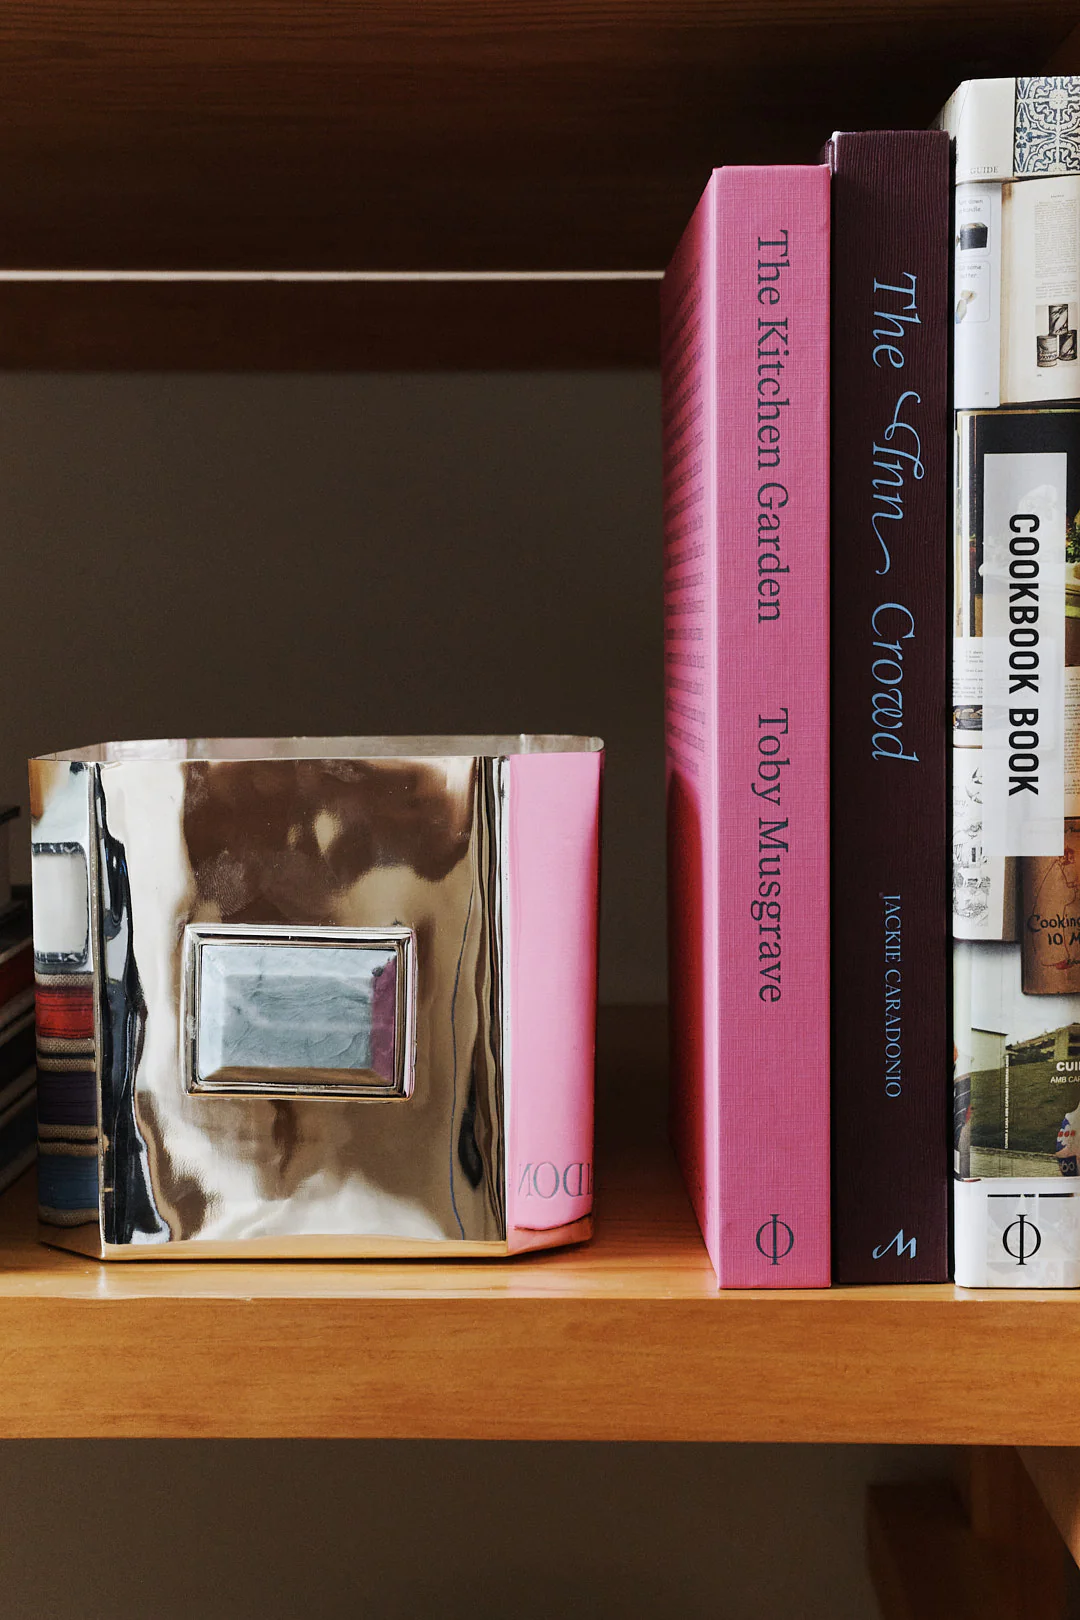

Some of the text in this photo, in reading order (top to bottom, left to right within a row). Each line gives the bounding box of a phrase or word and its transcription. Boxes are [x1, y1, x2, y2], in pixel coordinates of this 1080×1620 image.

[970, 166, 999, 174] GUIDE
[757, 229, 791, 624] The Kitchen Garden
[871, 271, 925, 762] The Inn Crowd
[1008, 513, 1040, 797] COOKBOOK BOOK
[750, 707, 791, 1003] Toby Musgrave
[882, 894, 902, 1098] JACKIE CARADONIO
[1047, 932, 1063, 945] 10
